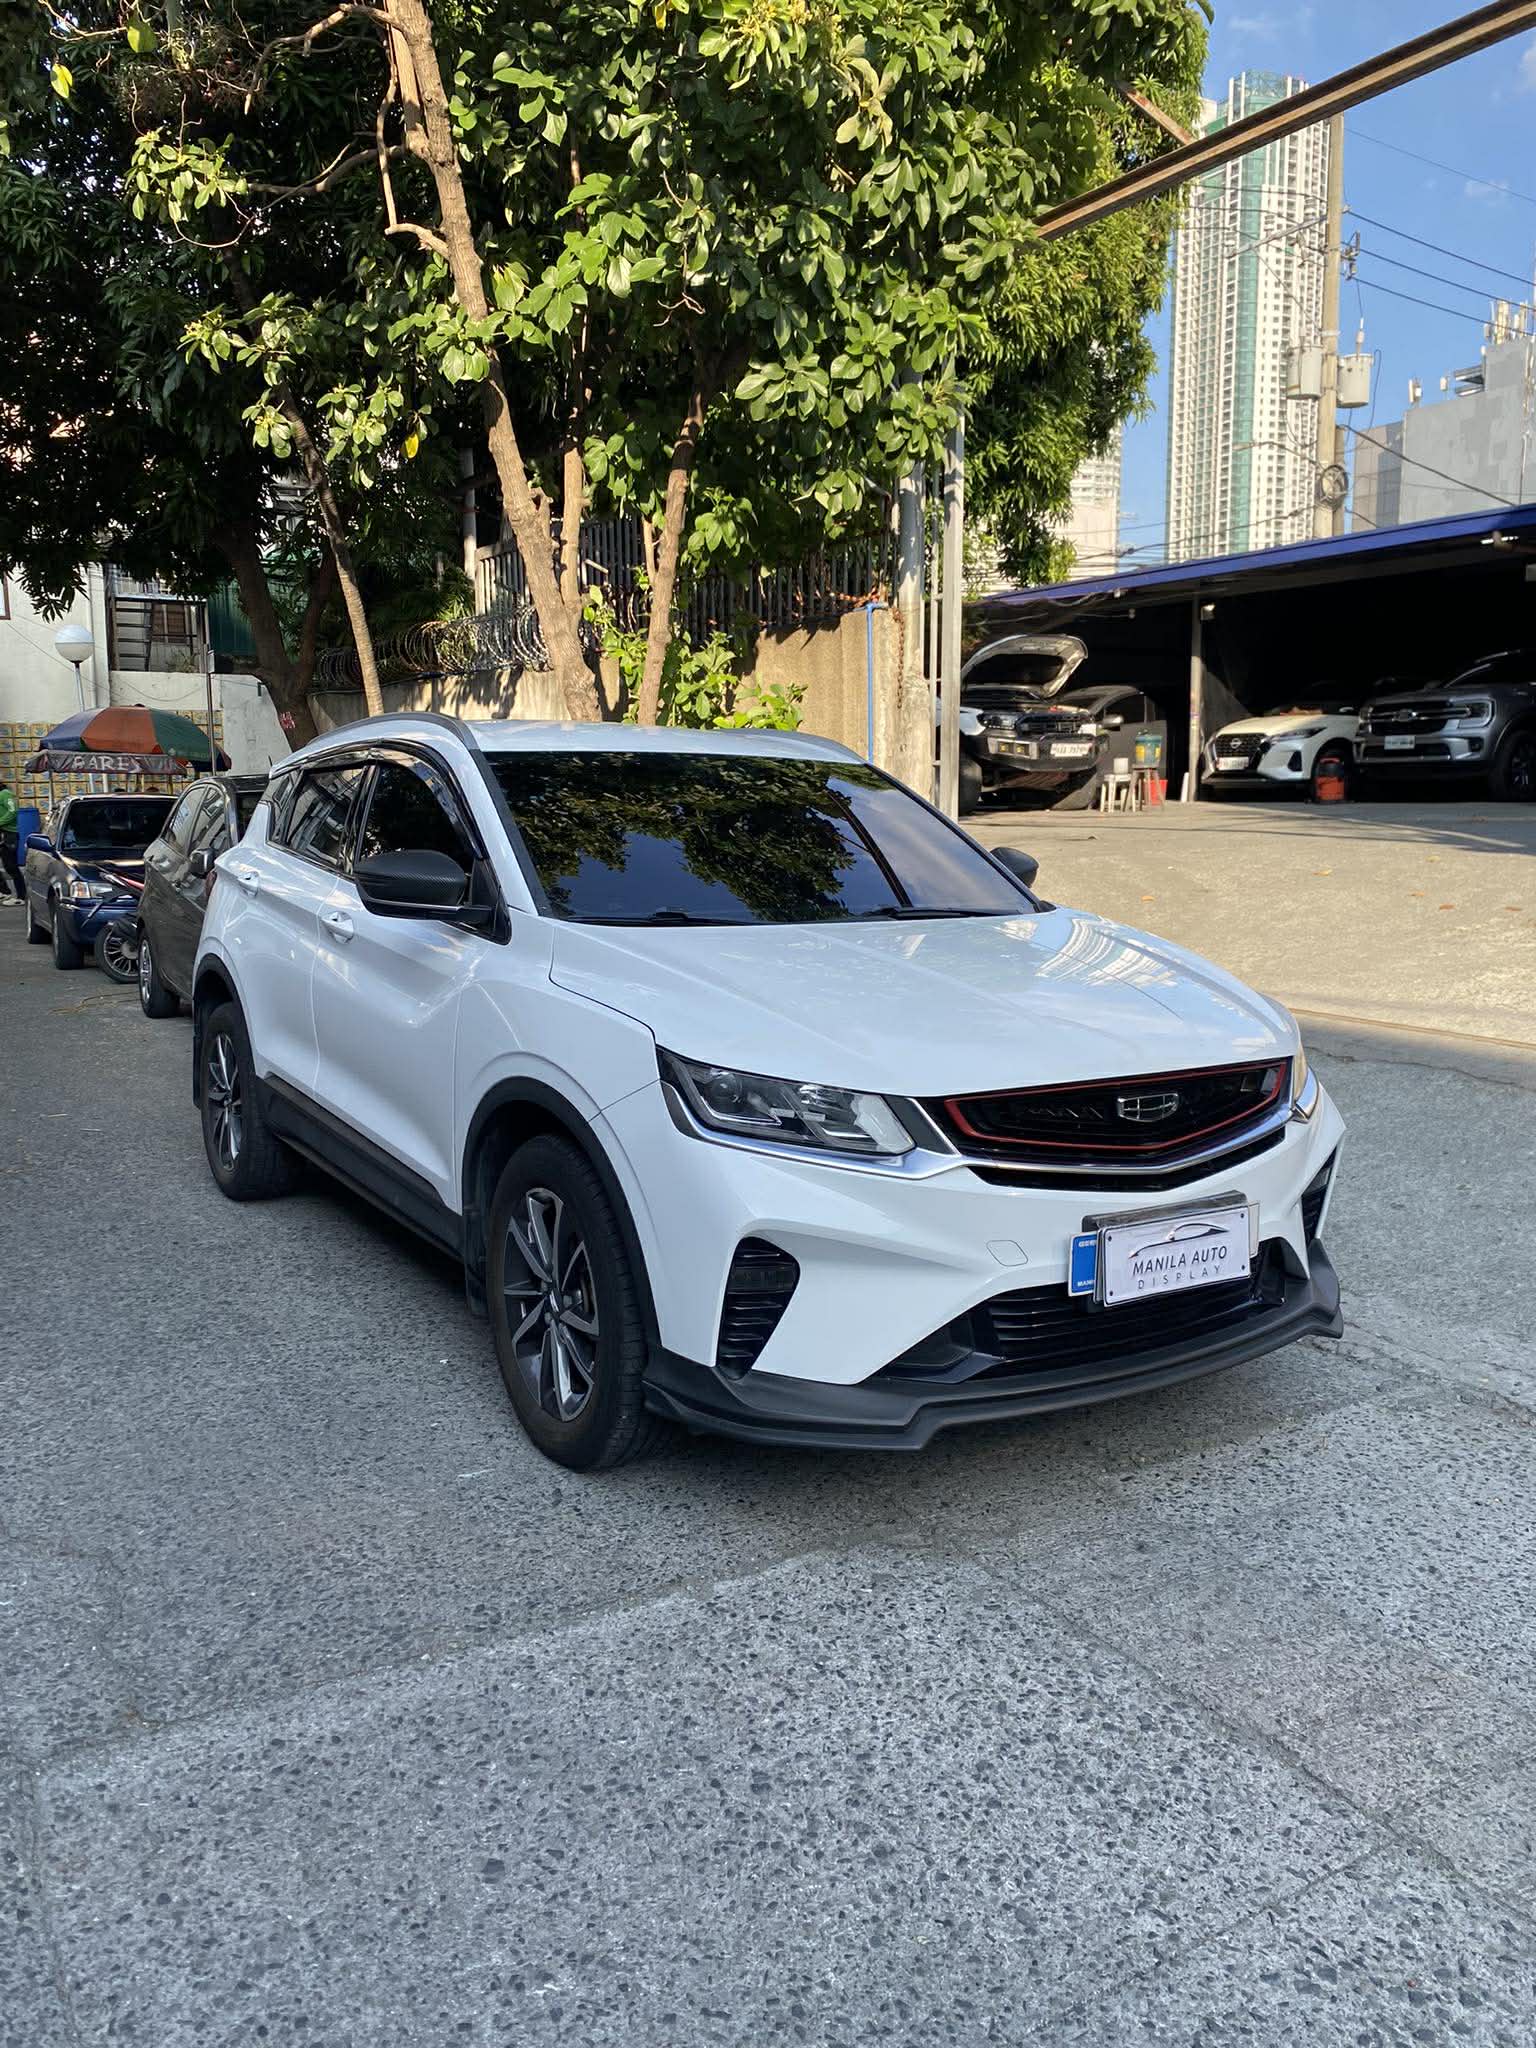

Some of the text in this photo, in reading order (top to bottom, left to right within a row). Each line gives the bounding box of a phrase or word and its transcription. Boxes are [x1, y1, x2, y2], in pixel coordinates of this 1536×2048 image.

[1132, 1245, 1228, 1276] MANILA AUTO
[1137, 1265, 1221, 1290] DISPLAY
